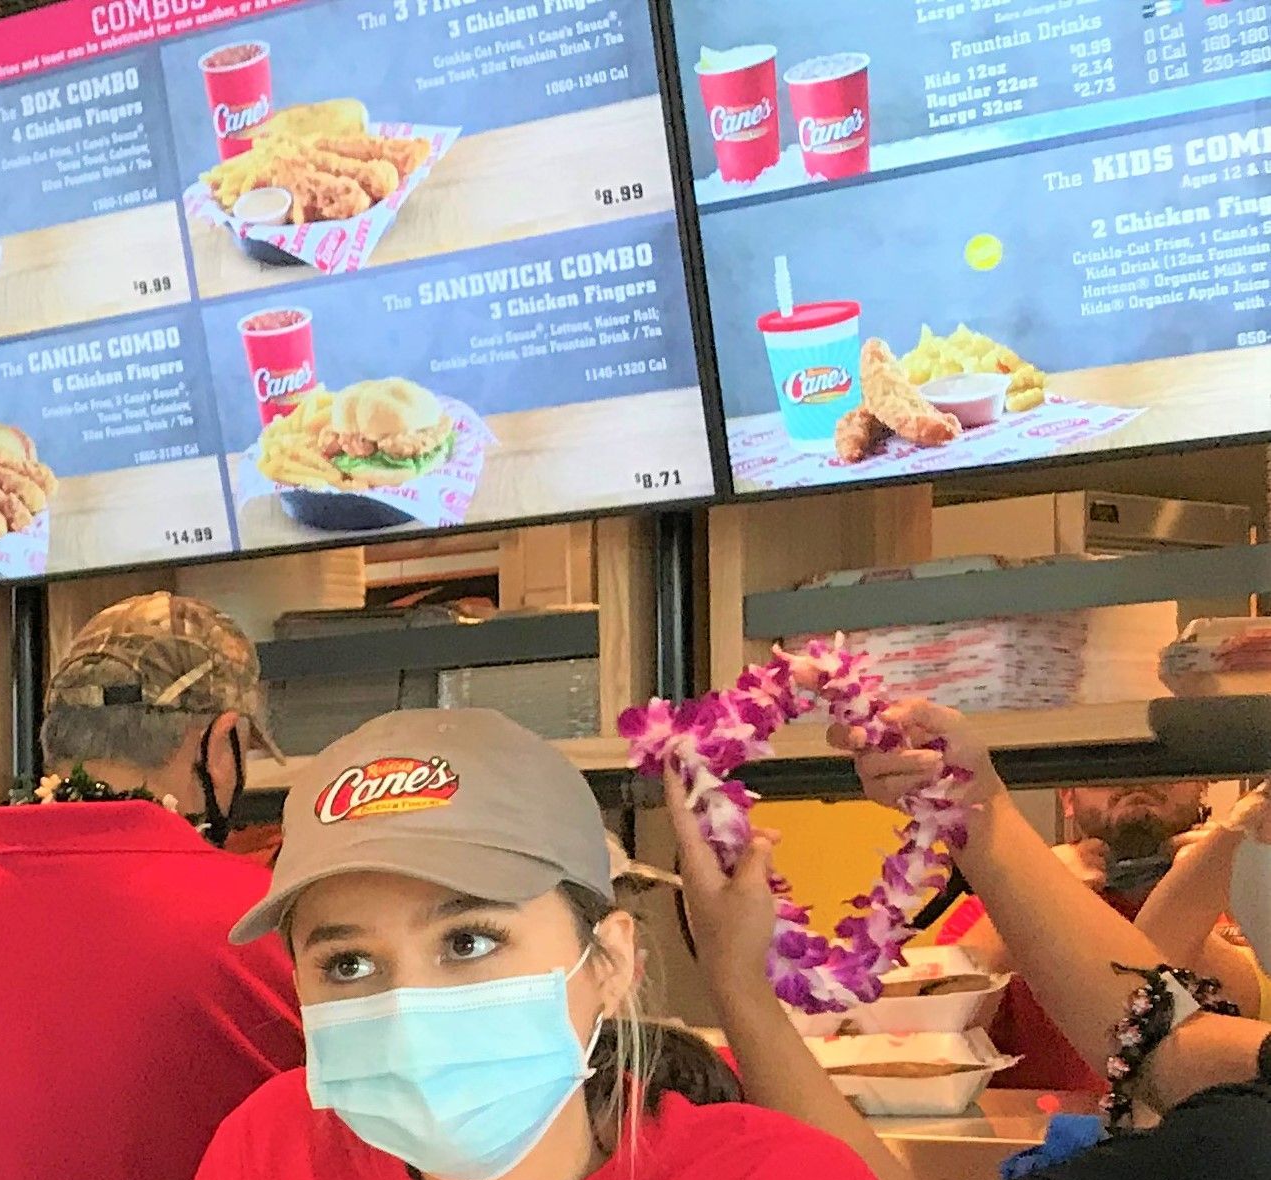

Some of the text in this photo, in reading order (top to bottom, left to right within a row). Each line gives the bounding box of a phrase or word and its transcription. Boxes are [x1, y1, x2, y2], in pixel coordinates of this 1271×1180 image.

[358, 12, 387, 31] The
[448, 20, 461, 40] 3
[466, 5, 538, 33] Chicken
[916, 3, 965, 23] Large
[560, 39, 591, 57] Drink
[603, 32, 624, 46] Tea
[950, 14, 1103, 59] Fountain Drinks
[609, 65, 629, 81] Cal
[925, 71, 960, 90] Kids
[967, 62, 1007, 81] 12oz
[1070, 37, 1111, 58] $0.99
[1144, 28, 1154, 45] 0
[1160, 21, 1184, 41] Cal
[20, 86, 62, 117] BOX
[66, 67, 140, 105] COMBO
[926, 86, 991, 109] Regular
[996, 76, 1038, 94] 22oz
[1071, 57, 1114, 78] $2.34
[1162, 41, 1187, 60] Cal
[929, 109, 977, 129] Large
[981, 98, 1023, 117] 32oz
[1073, 76, 1116, 97] $2.73
[1149, 68, 1159, 84] 0
[1164, 61, 1189, 80] Cal
[25, 116, 83, 140] Chicken
[85, 100, 143, 127] Fingers
[710, 96, 773, 141] Cane's
[799, 107, 864, 152] Cane's
[1043, 171, 1082, 191] The
[1092, 144, 1174, 183] KIDS
[1182, 172, 1218, 189] Ages
[1223, 165, 1241, 181] 12
[595, 183, 644, 205] $8.99
[1090, 219, 1107, 239] 2
[1115, 206, 1211, 235] Chicken
[1200, 232, 1206, 244] 1
[382, 243, 654, 313] The SANDWICH COMBO
[1086, 266, 1116, 280] Kids
[1121, 258, 1159, 275] Drink
[1208, 243, 1270, 260] Fountain
[1154, 270, 1210, 288] Organic
[1214, 262, 1247, 279] Milk
[1251, 261, 1267, 272] or
[489, 279, 657, 321] 3 Chicken Fingers
[1128, 291, 1184, 309] Organic
[1188, 284, 1229, 301] Apple
[0, 326, 180, 378] The CANIAC COMBO
[599, 329, 630, 345] Drink
[66, 369, 123, 391] Chicken
[126, 360, 184, 381] Fingers
[648, 357, 667, 372] Cal
[784, 364, 852, 403] Cane's
[635, 470, 682, 489] $8.71
[319, 757, 456, 823] Cane's
